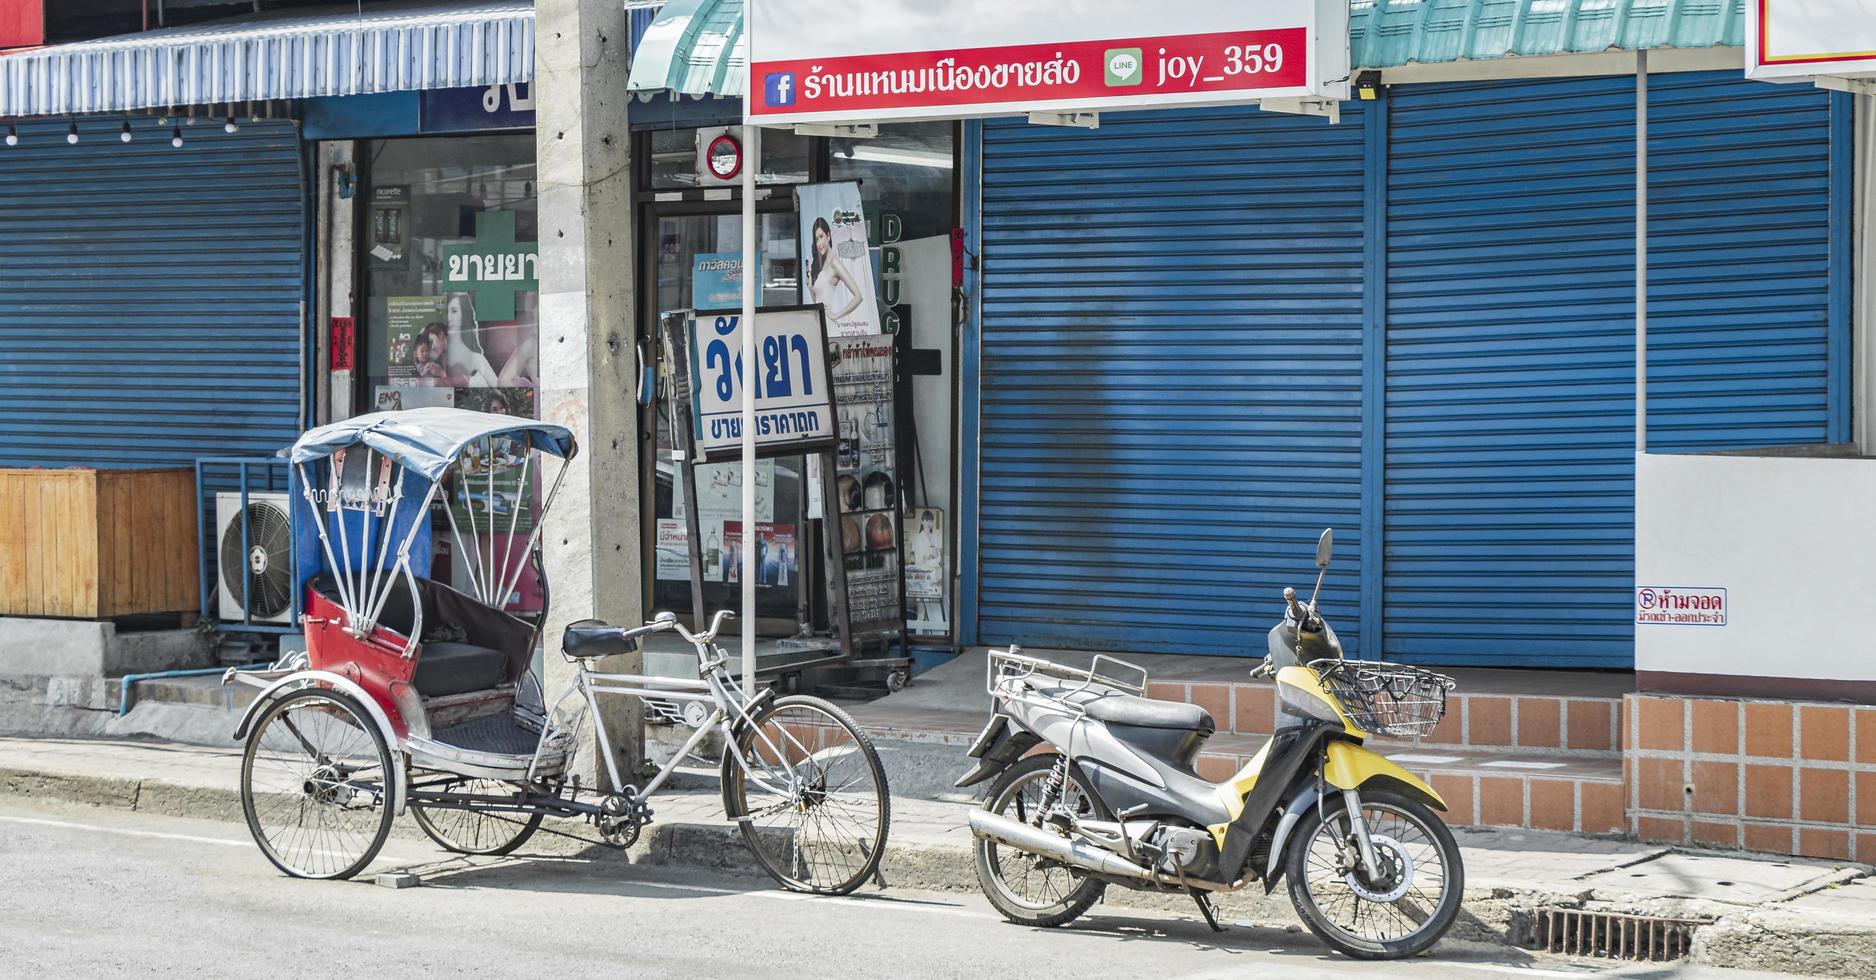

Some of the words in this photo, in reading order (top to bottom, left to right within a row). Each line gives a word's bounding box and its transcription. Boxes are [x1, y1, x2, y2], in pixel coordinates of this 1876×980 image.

[803, 51, 1080, 99] ร้านแหนมเนืองขายส่ง
[1114, 61, 1133, 70] LINE
[1156, 43, 1283, 87] joy_359
[448, 252, 539, 281] ขายยา
[378, 390, 400, 405] ENO
[711, 410, 819, 440] ขายาราคาถูก
[1658, 589, 1722, 609] ห้ามจอด
